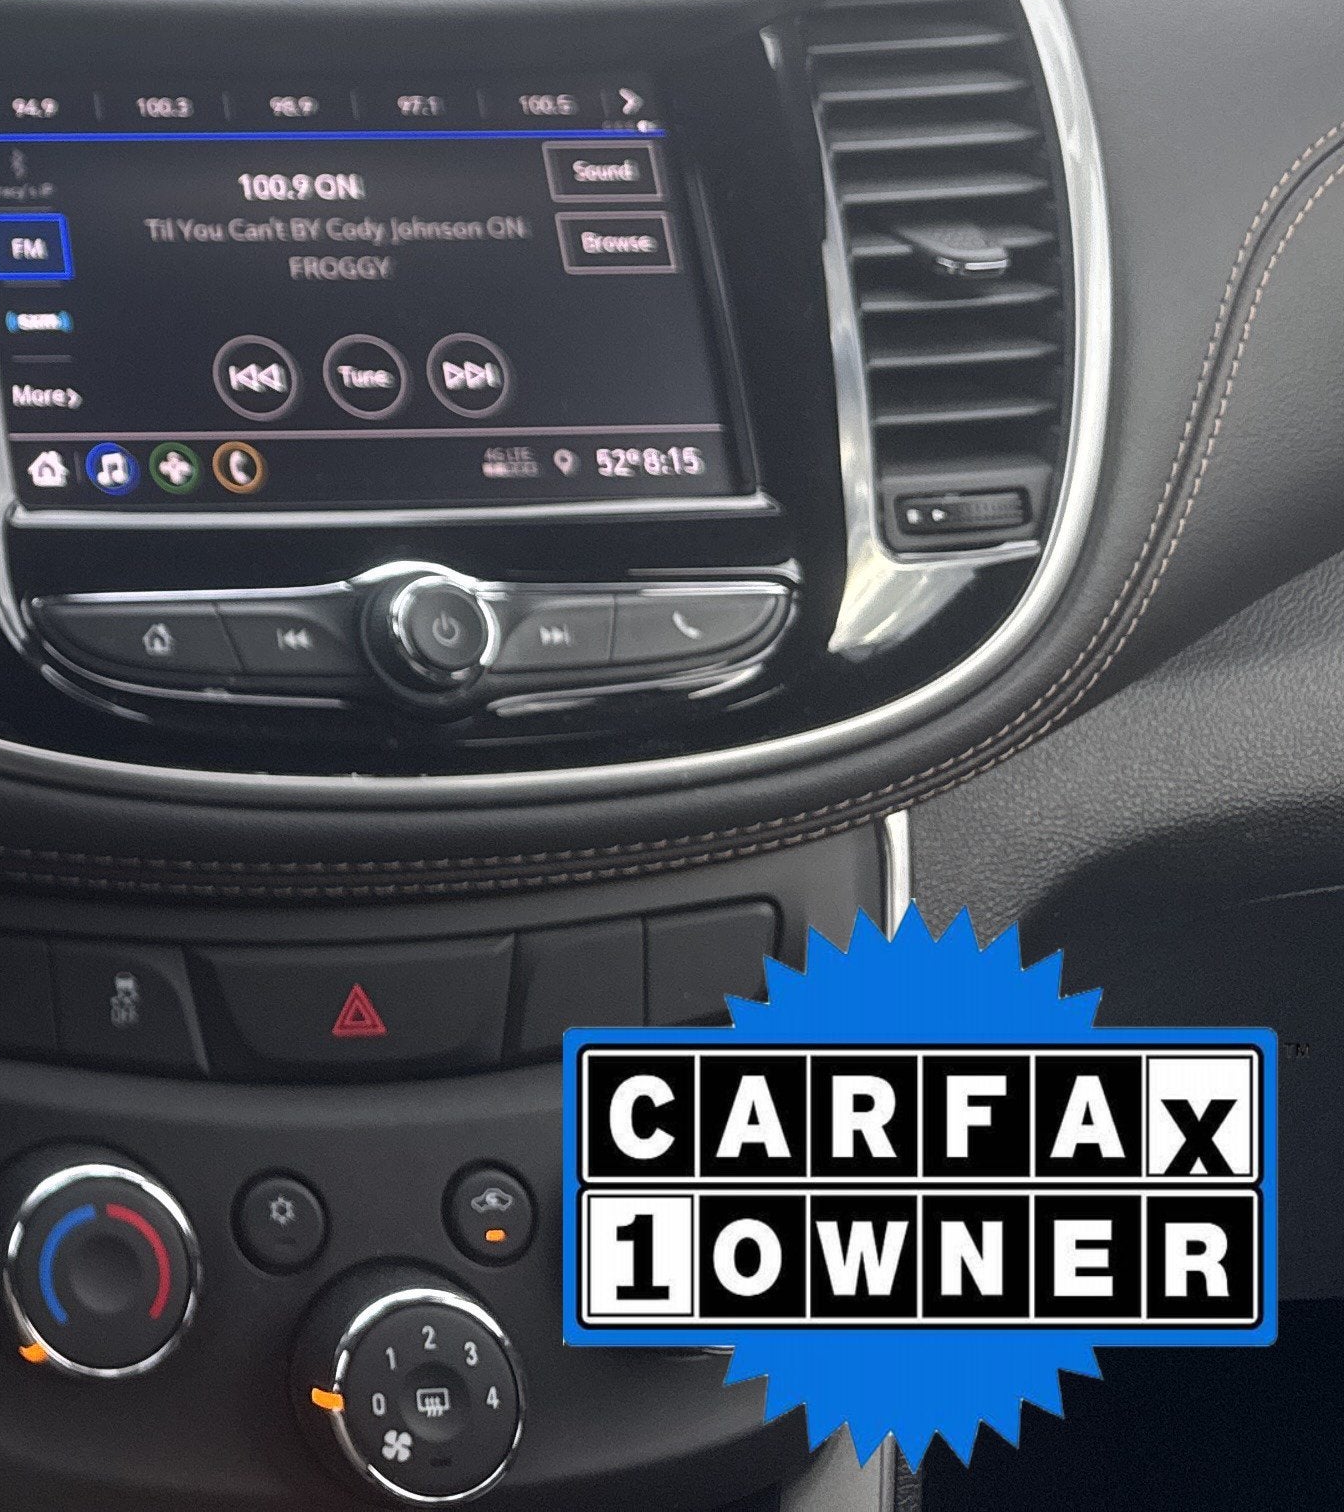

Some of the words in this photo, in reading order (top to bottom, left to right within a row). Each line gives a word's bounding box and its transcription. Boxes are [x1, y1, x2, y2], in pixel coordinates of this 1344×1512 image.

[11, 97, 60, 119] 94.9
[135, 96, 194, 118] 100.3
[572, 159, 641, 182] Sound
[238, 172, 312, 201] 100.9
[313, 172, 366, 201] ON
[144, 217, 176, 242] Til
[176, 218, 223, 243] You
[228, 216, 287, 242] Can't
[289, 217, 321, 241] BY
[325, 217, 385, 247] Cody
[389, 217, 484, 245] Johnson
[485, 215, 530, 240] ON
[581, 231, 659, 254] Browse
[11, 237, 49, 260] FM
[288, 255, 396, 281] FROGGY
[337, 364, 395, 388] Tune
[12, 384, 68, 408] More
[421, 1325, 438, 1350] 2
[385, 1346, 396, 1371] 1
[463, 1341, 479, 1366] 3
[371, 1392, 387, 1416] 0
[486, 1386, 500, 1410] 4
